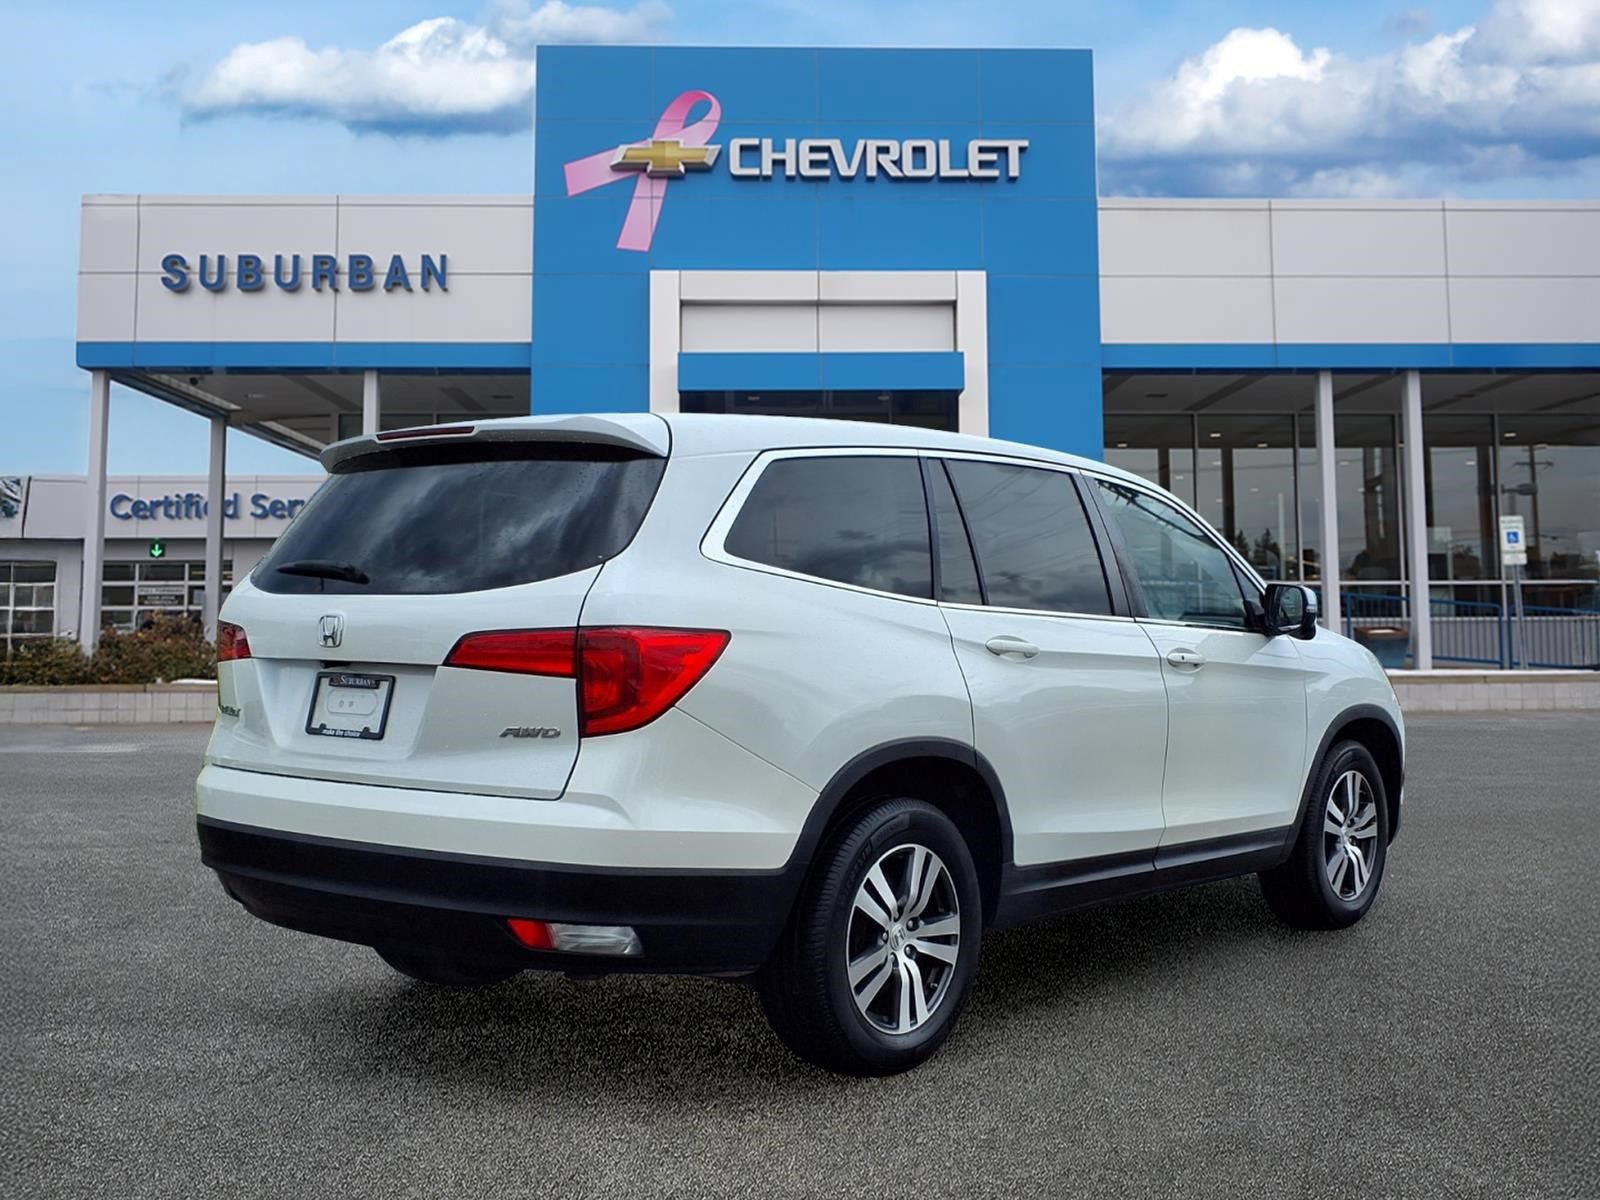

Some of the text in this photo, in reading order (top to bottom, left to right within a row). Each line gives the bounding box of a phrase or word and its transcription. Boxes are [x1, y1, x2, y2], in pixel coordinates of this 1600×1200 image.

[728, 137, 1029, 178] CHEVROLET
[160, 254, 448, 292] SUBURBAN
[110, 493, 305, 520] Certifid Ser
[499, 726, 561, 738] AWD
